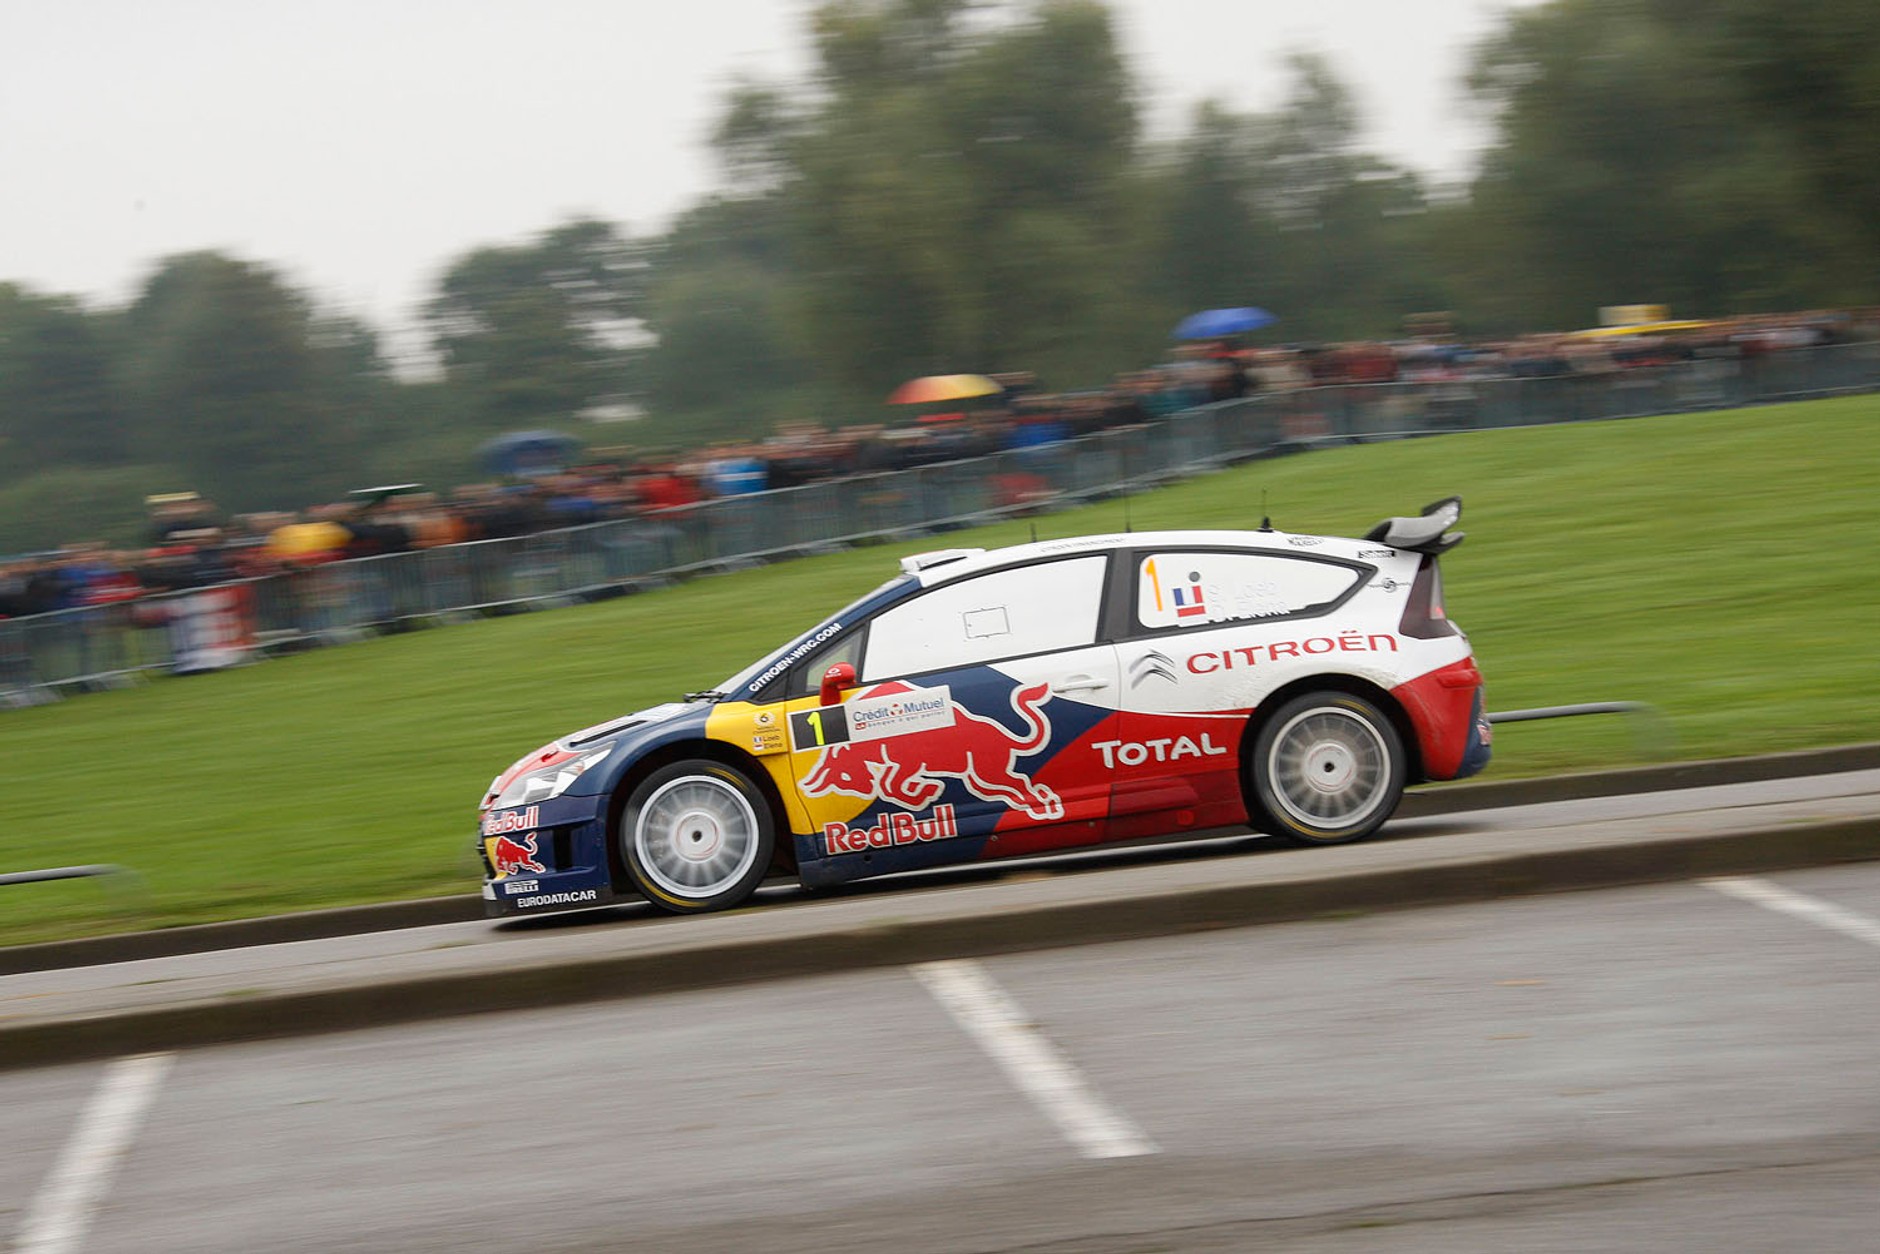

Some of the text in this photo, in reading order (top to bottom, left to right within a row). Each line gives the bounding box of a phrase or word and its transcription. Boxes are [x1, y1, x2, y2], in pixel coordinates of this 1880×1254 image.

[1144, 558, 1163, 612] 1
[748, 622, 843, 693] CITROEN-WRC.COM
[903, 697, 945, 713] Mutuel
[806, 711, 825, 746] 1
[1091, 732, 1227, 769] TOTAL
[517, 889, 598, 908] EURODATACAR
